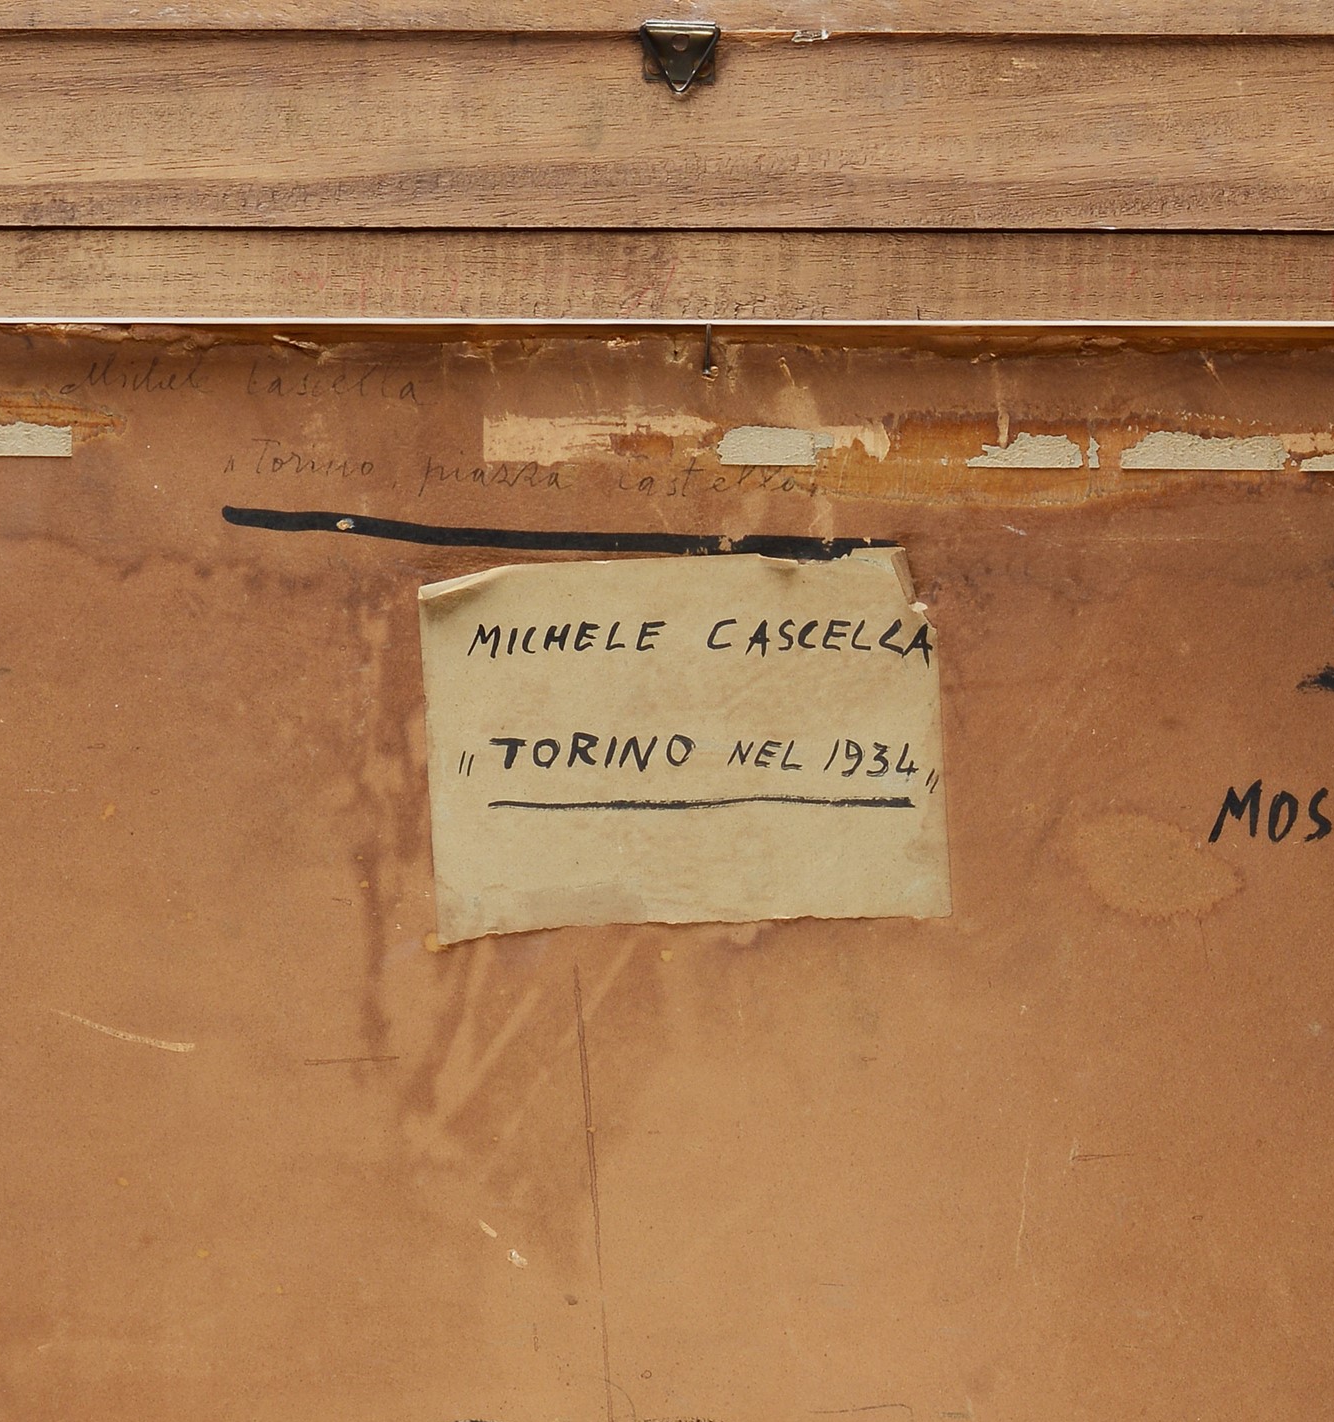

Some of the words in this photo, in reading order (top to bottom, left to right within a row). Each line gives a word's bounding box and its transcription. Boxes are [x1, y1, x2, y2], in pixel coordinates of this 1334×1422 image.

[467, 620, 667, 658] MICHELE
[707, 618, 934, 668] CASCELLA
[727, 739, 803, 771] NEL
